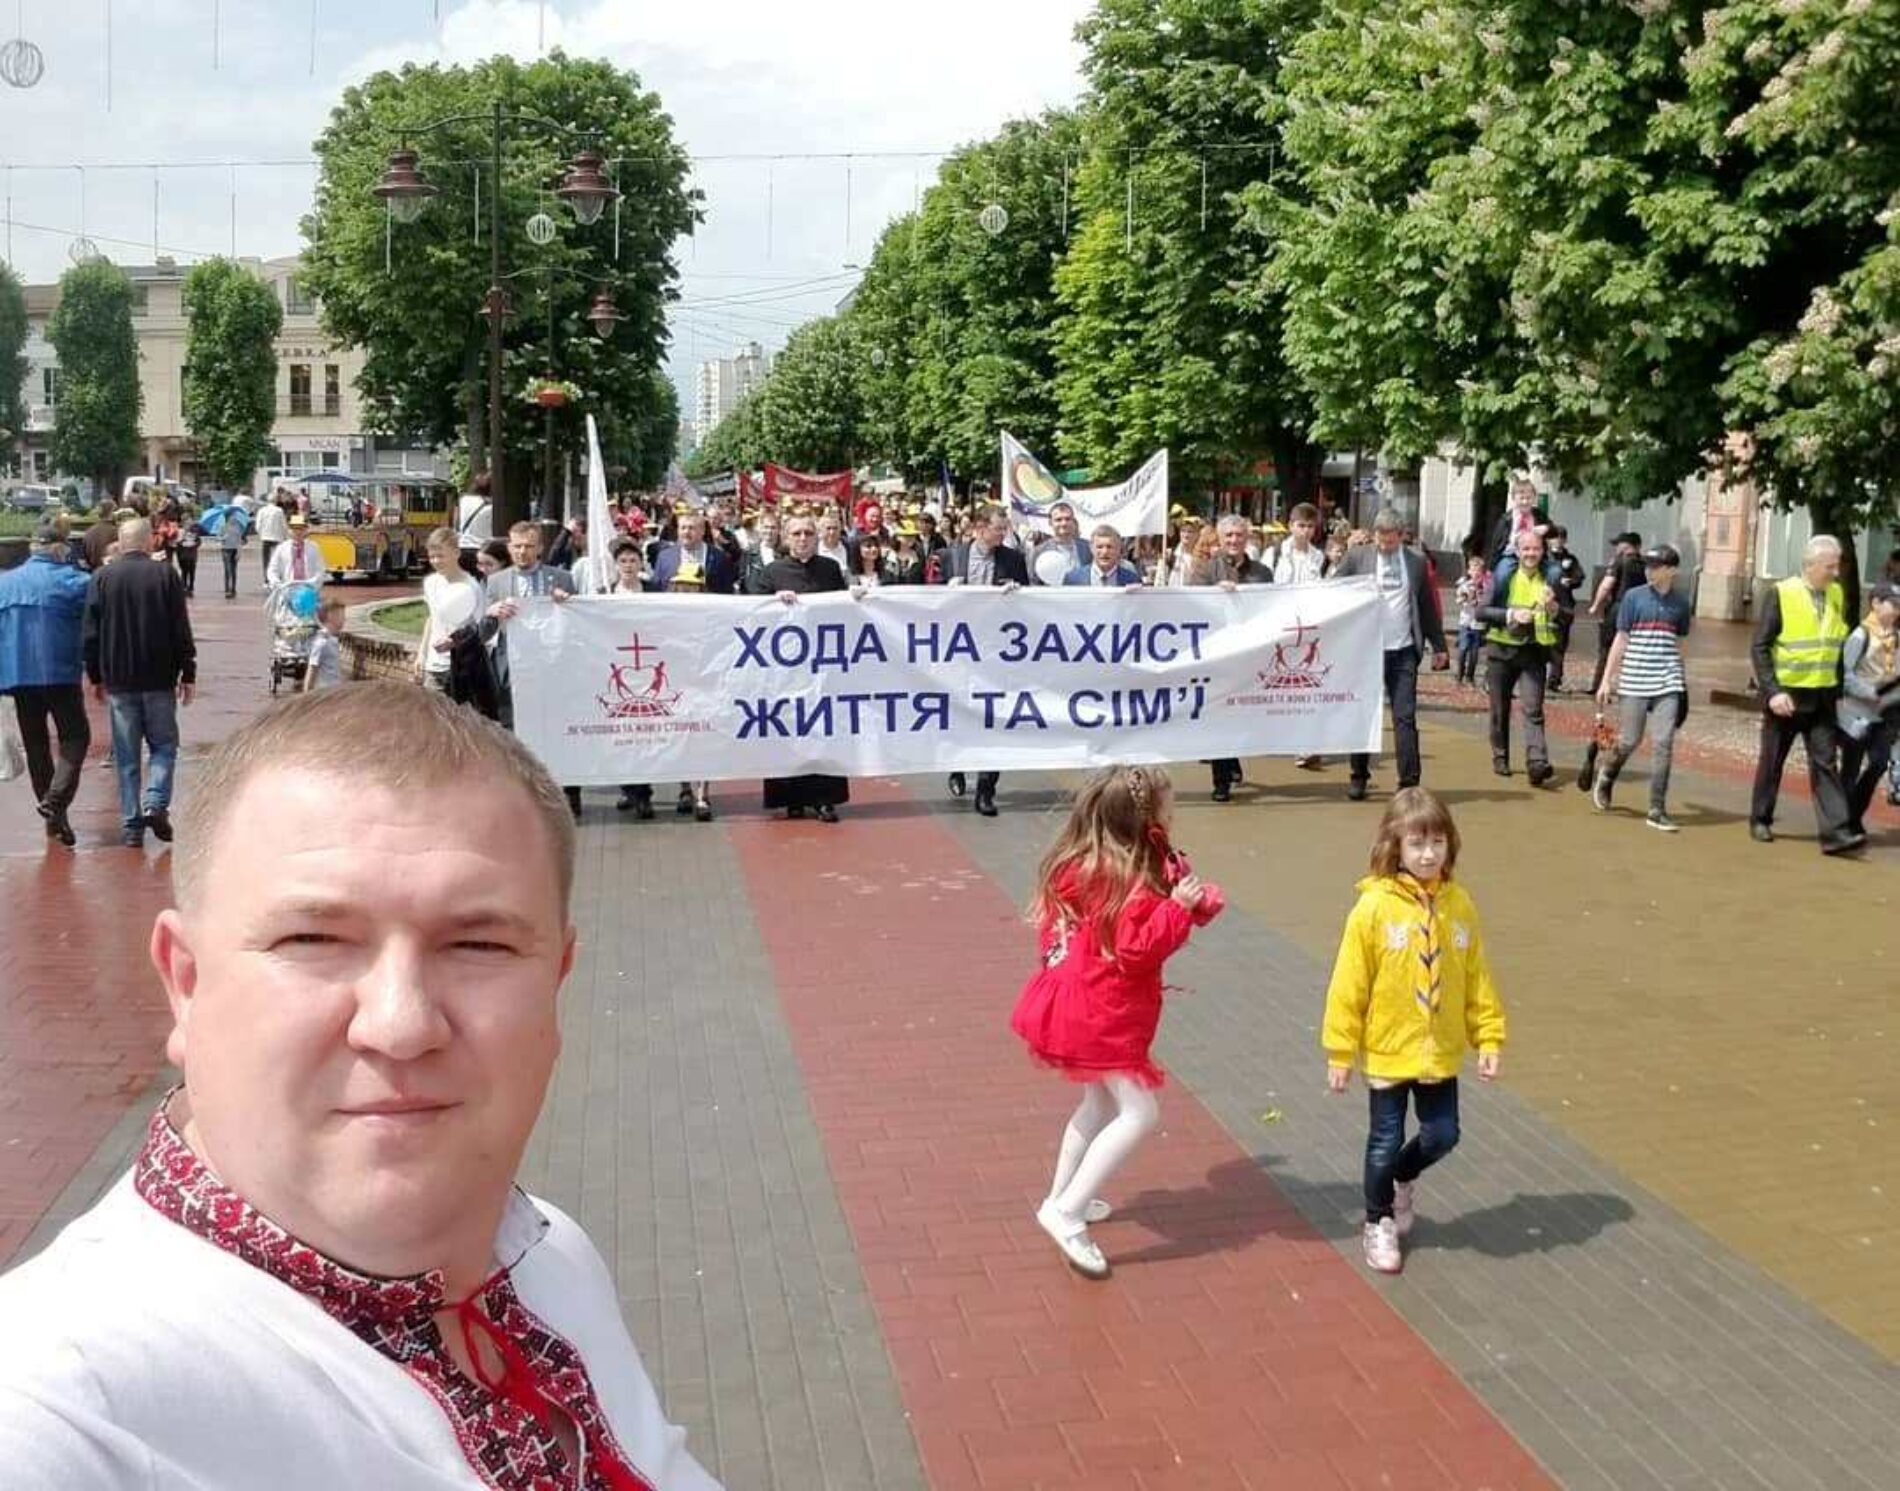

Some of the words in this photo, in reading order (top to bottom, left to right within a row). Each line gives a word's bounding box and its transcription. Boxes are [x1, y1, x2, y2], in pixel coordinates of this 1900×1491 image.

[733, 622, 888, 674] ХОДА
[907, 622, 981, 663] НА
[999, 621, 1210, 663] ЗАХИСТ
[733, 692, 950, 739] ЖИТТЯ
[971, 690, 1048, 729] ТА
